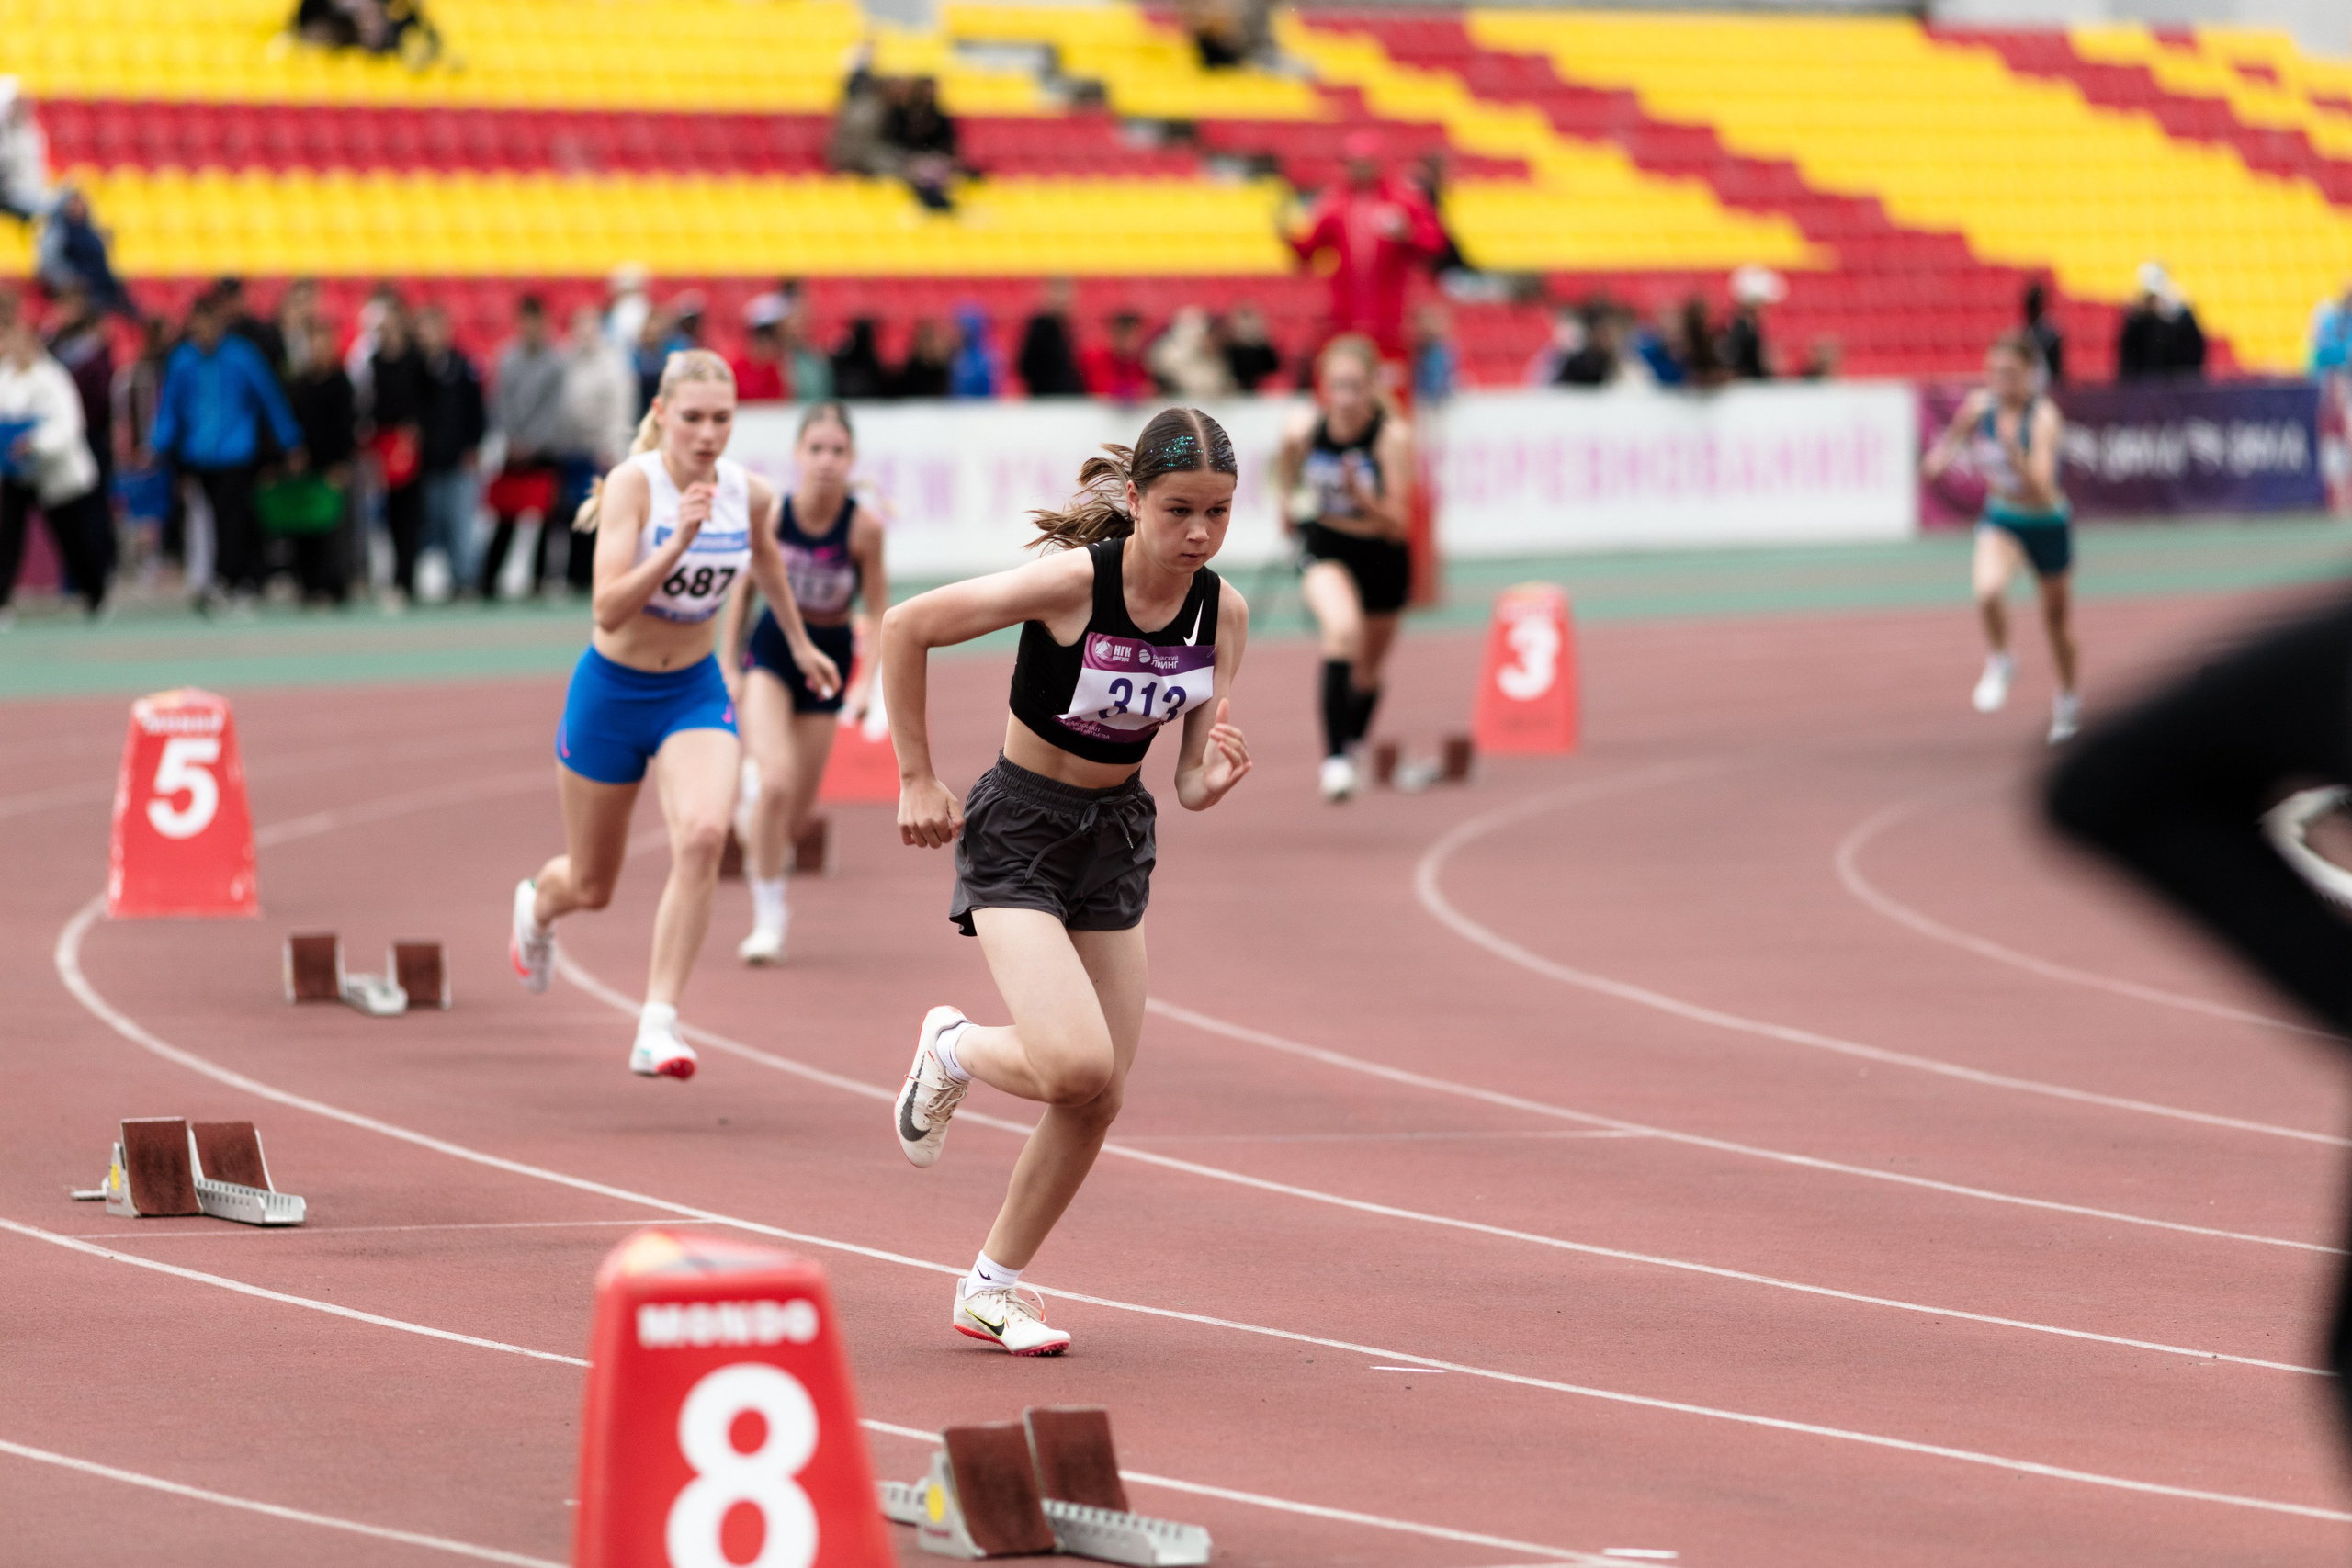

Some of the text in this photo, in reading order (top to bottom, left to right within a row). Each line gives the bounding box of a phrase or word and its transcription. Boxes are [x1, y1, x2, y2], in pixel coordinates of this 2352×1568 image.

[662, 566, 737, 599] 687
[1113, 645, 1132, 658] НГК
[1496, 614, 1561, 701] 3
[1099, 677, 1187, 723] 313
[145, 736, 222, 840] 5
[636, 1297, 820, 1349] MONDO
[663, 1360, 820, 1568] 8
